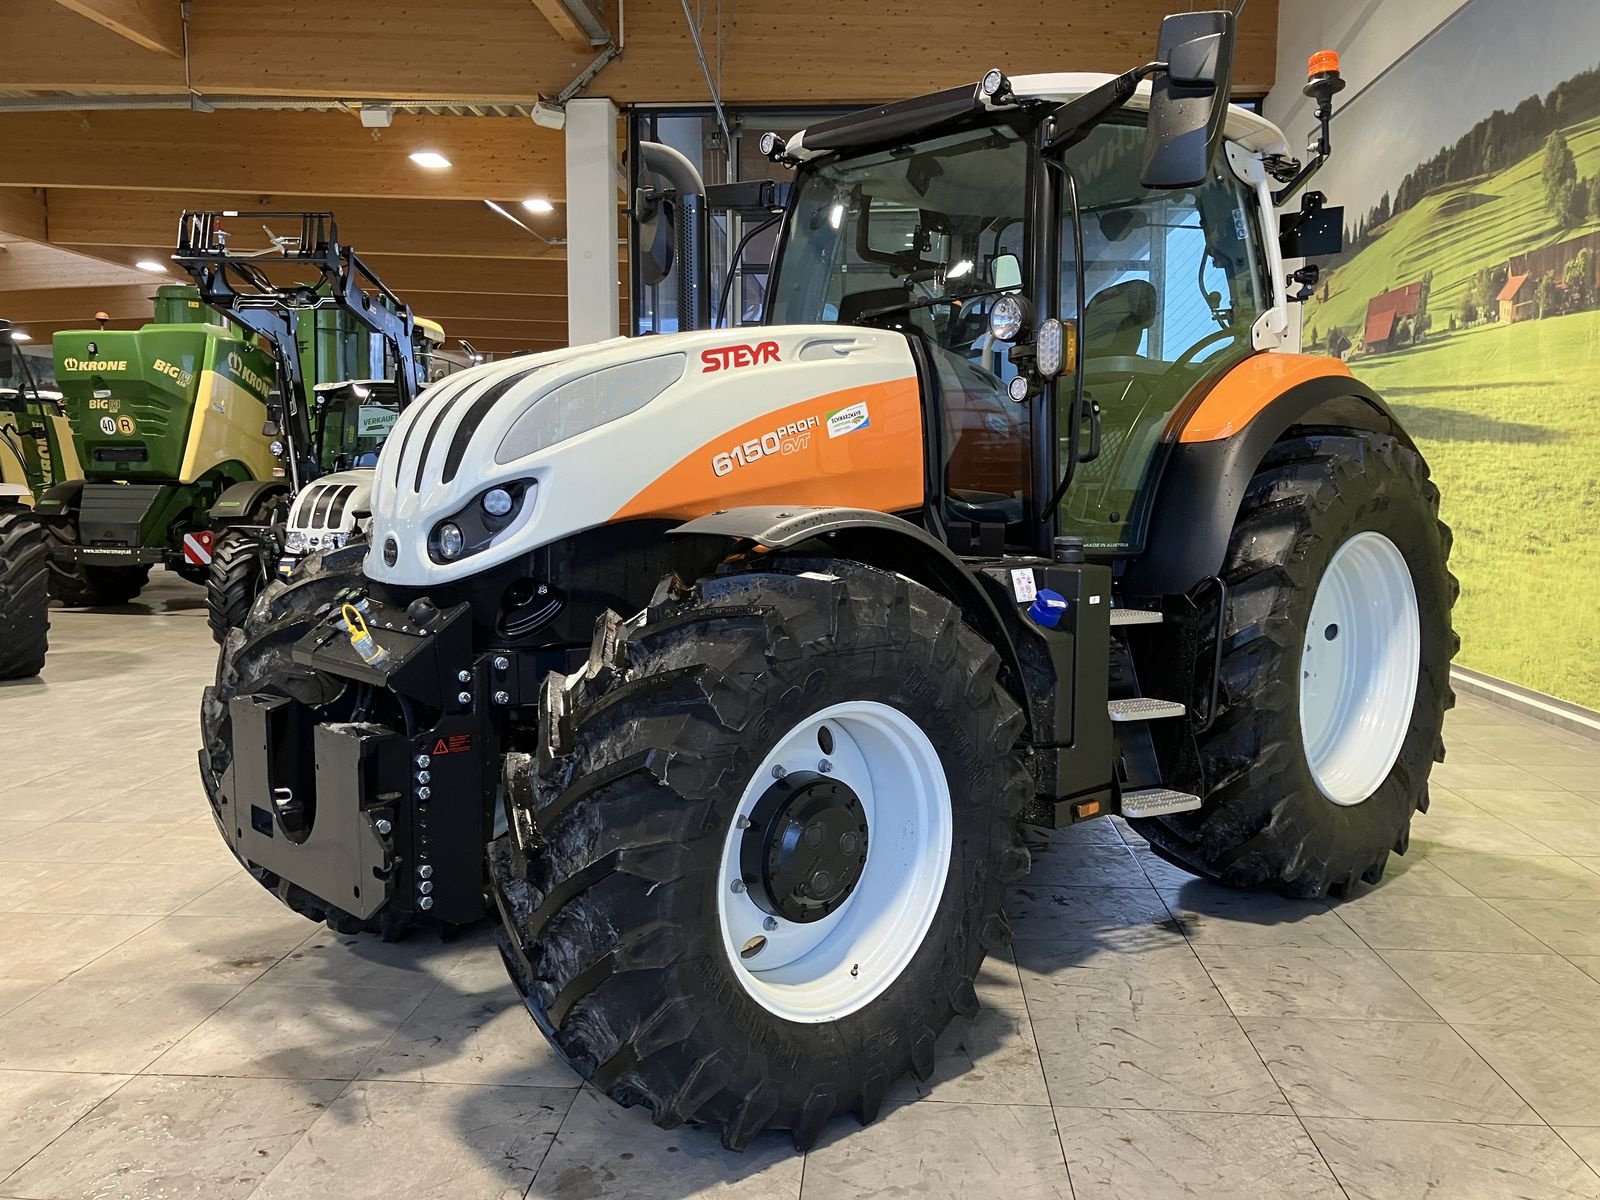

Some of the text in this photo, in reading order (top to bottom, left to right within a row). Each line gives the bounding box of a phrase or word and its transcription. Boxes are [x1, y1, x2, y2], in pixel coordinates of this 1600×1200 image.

[79, 360, 127, 371] KRONE
[701, 341, 782, 373] STEYR
[242, 366, 270, 398] KRON
[102, 419, 114, 432] 40
[121, 419, 131, 431] R
[363, 414, 398, 425] VERKAUFT
[831, 410, 862, 424] SCHWARZMAYR
[776, 416, 820, 439] PROFI
[781, 432, 811, 456] CVT
[712, 431, 781, 477] 6150
